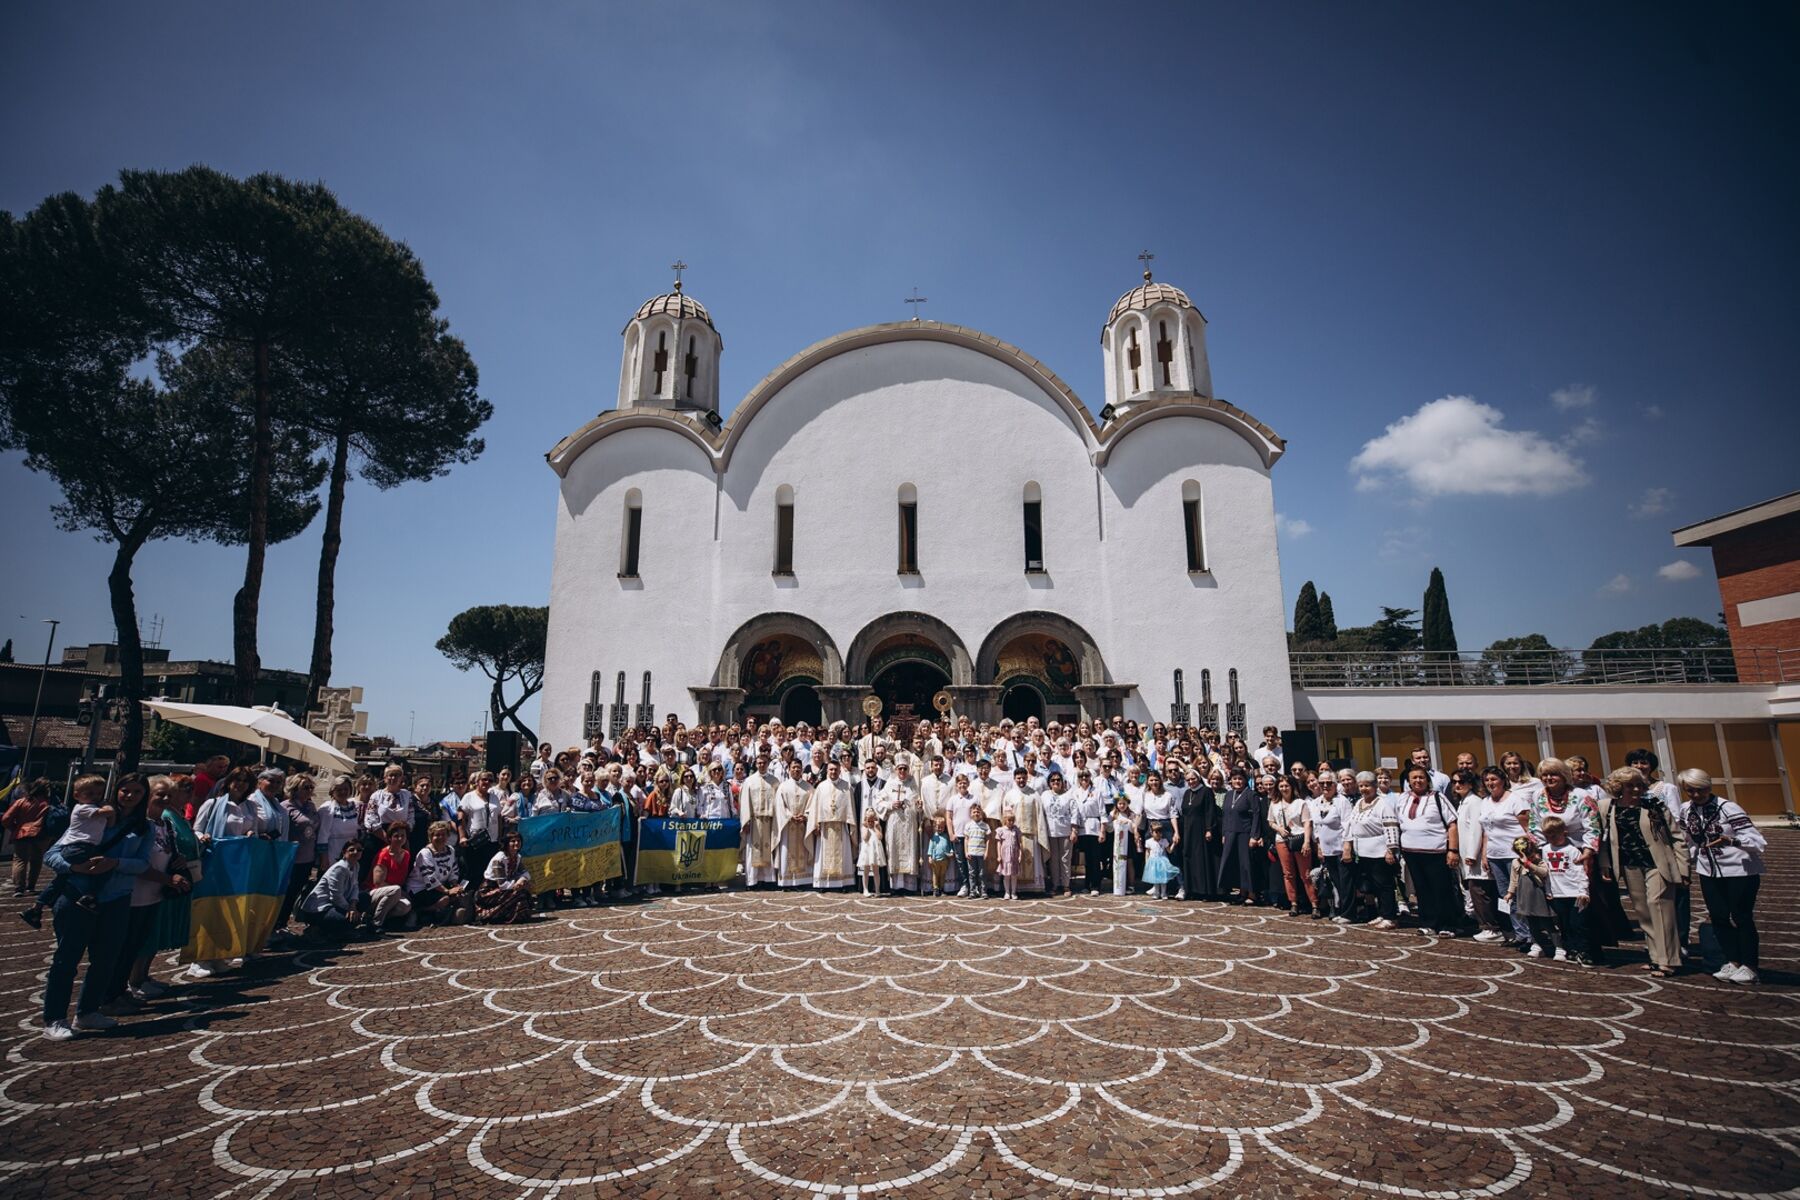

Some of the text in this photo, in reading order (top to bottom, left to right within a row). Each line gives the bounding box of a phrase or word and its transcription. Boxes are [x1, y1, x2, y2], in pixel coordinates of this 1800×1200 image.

[662, 820, 723, 830] I Stand With
[671, 871, 702, 880] Ukraine
